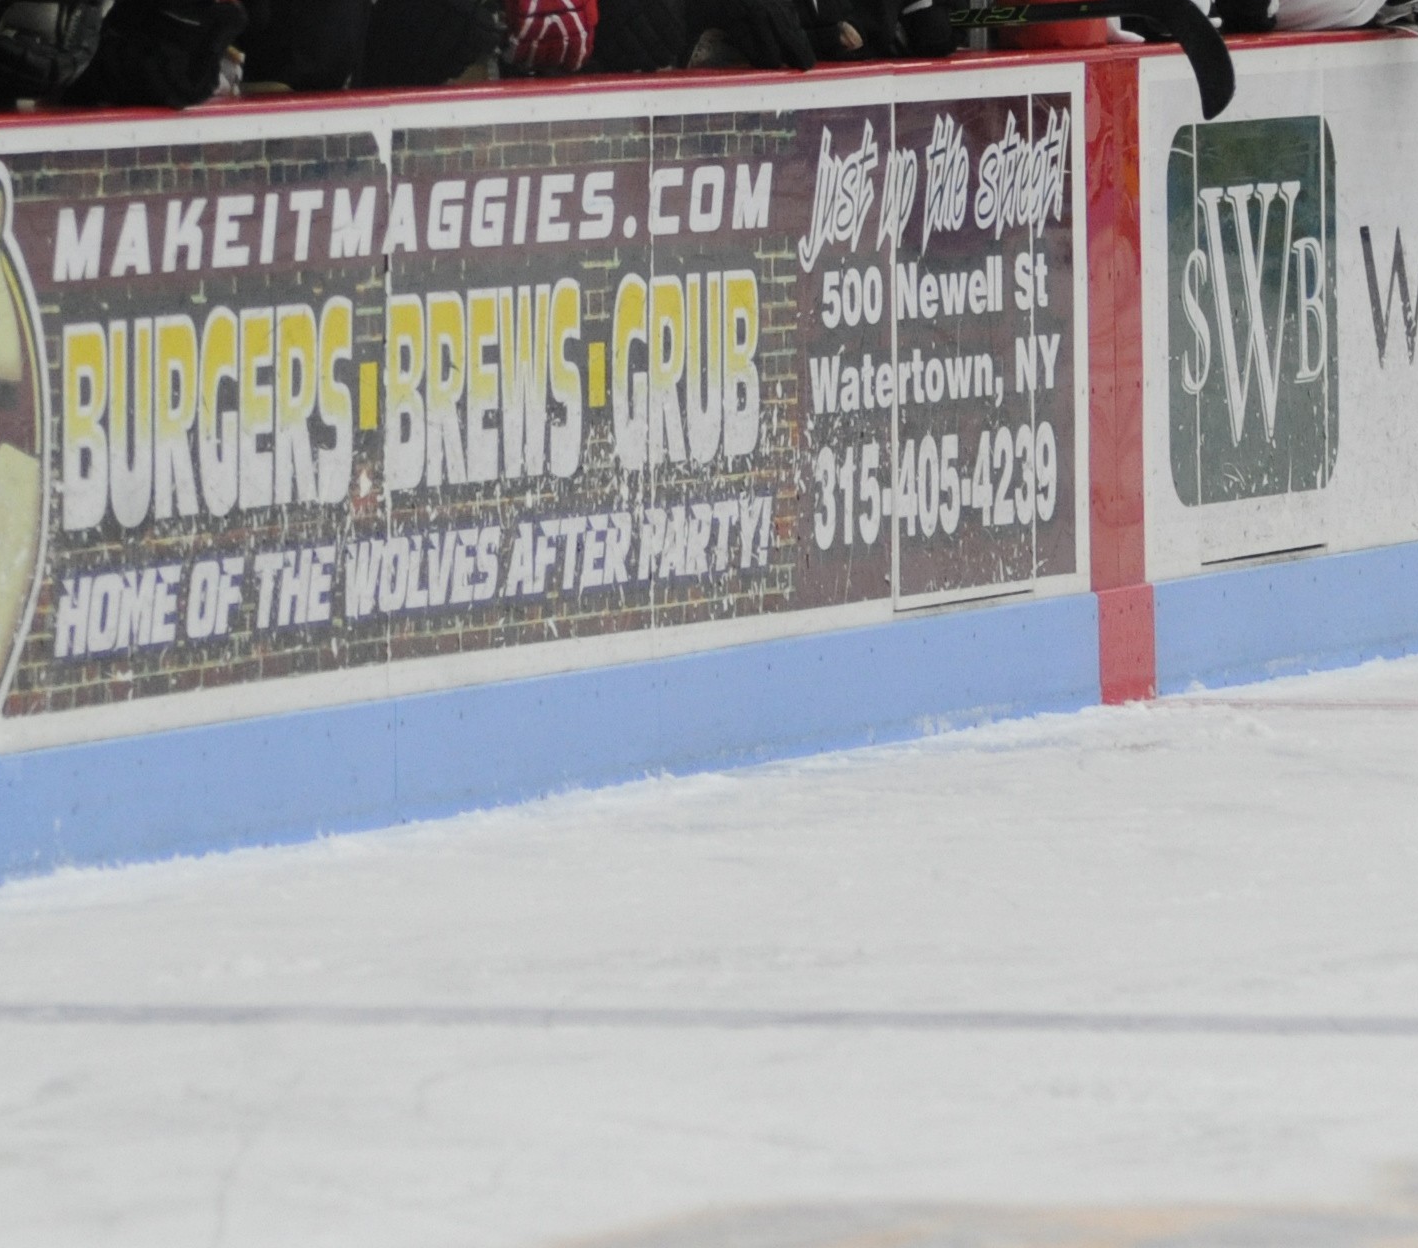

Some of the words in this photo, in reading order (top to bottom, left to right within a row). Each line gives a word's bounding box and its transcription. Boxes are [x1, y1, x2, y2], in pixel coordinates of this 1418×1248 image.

[53, 162, 774, 282] MAKEITMAGGIES.COM
[922, 113, 969, 255] the
[821, 268, 881, 328] 500
[896, 252, 1003, 320] Newell
[1014, 252, 1048, 309] St
[62, 296, 354, 532] BURGERS
[387, 277, 582, 492] BREWS
[611, 269, 760, 462] GRUB
[810, 349, 1004, 414] Watertown,
[1014, 334, 1061, 391] NY
[813, 421, 1058, 551] 315-405-4239
[54, 565, 181, 659] HOME
[186, 557, 243, 638] OF
[254, 544, 333, 630] THE
[344, 527, 500, 621] WOLVES
[504, 510, 632, 597] AFTER
[638, 490, 774, 582] PARTY!
